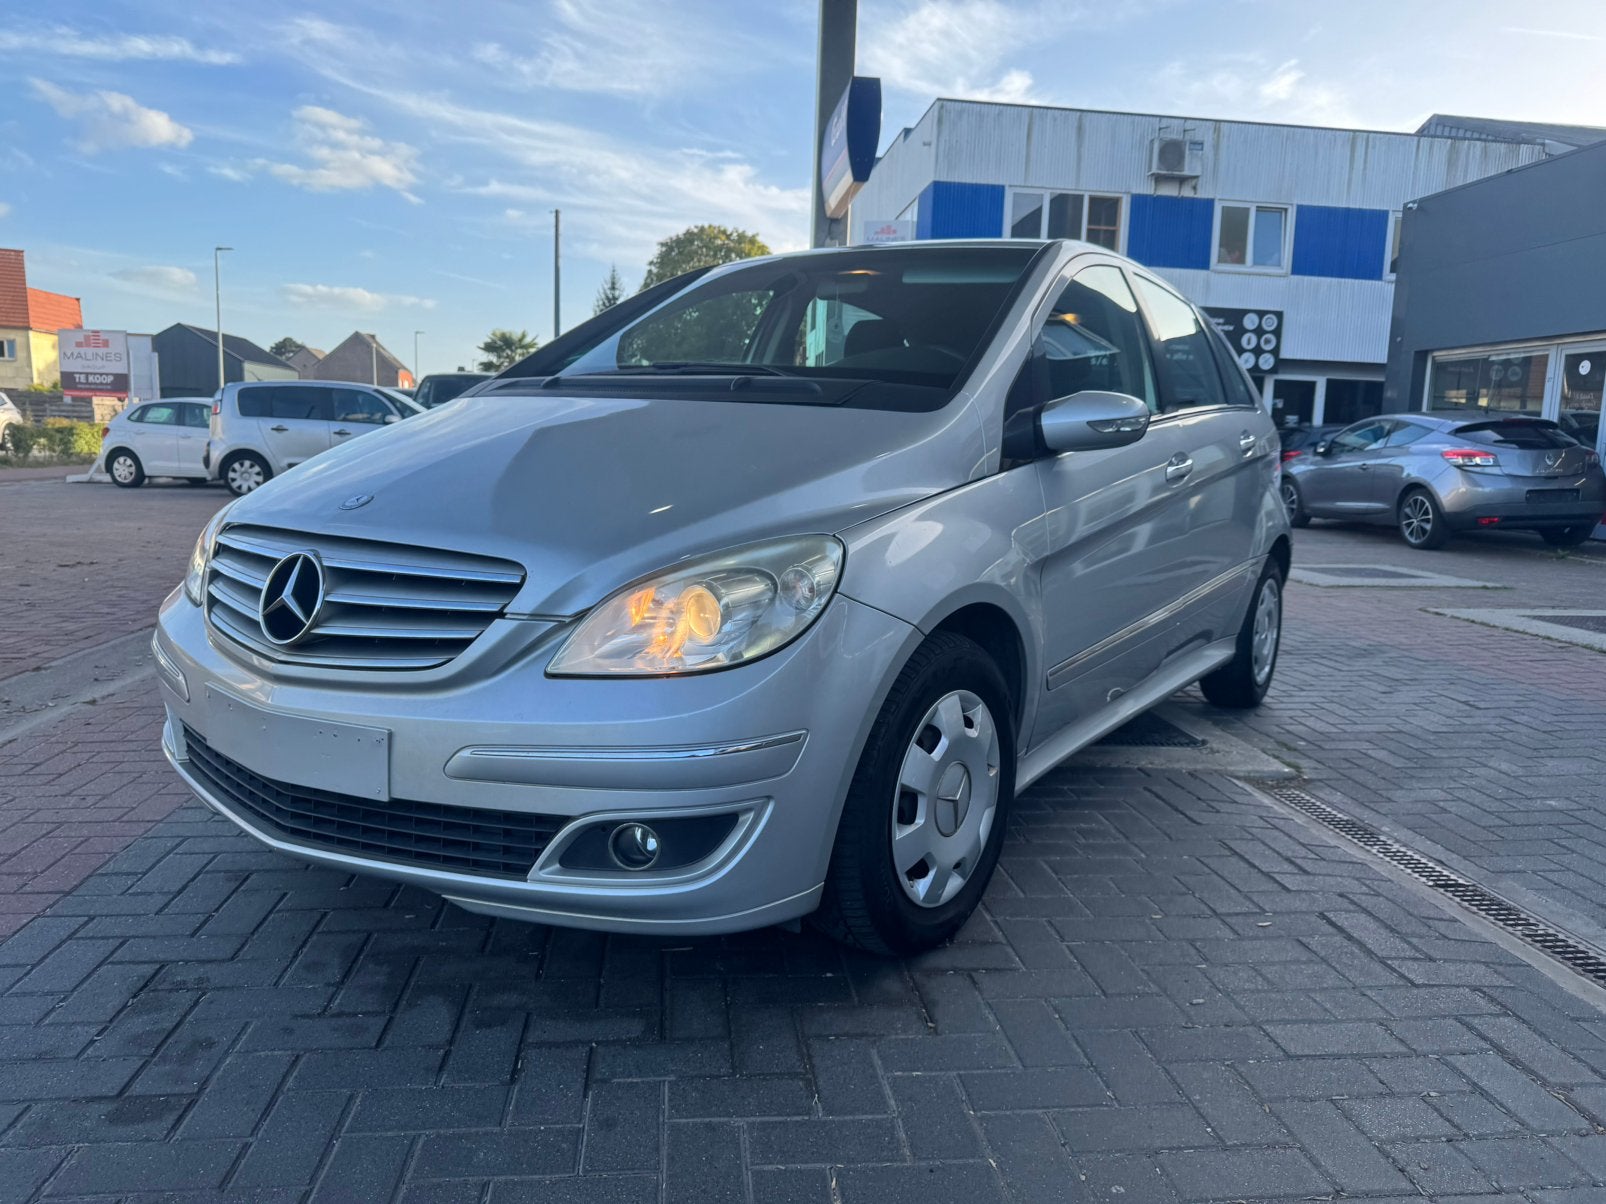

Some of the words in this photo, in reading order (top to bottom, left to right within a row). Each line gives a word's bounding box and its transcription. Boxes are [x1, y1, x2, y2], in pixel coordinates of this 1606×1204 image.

[62, 351, 122, 362] MALINES
[73, 374, 87, 384] TE
[88, 374, 114, 384] KOOP
